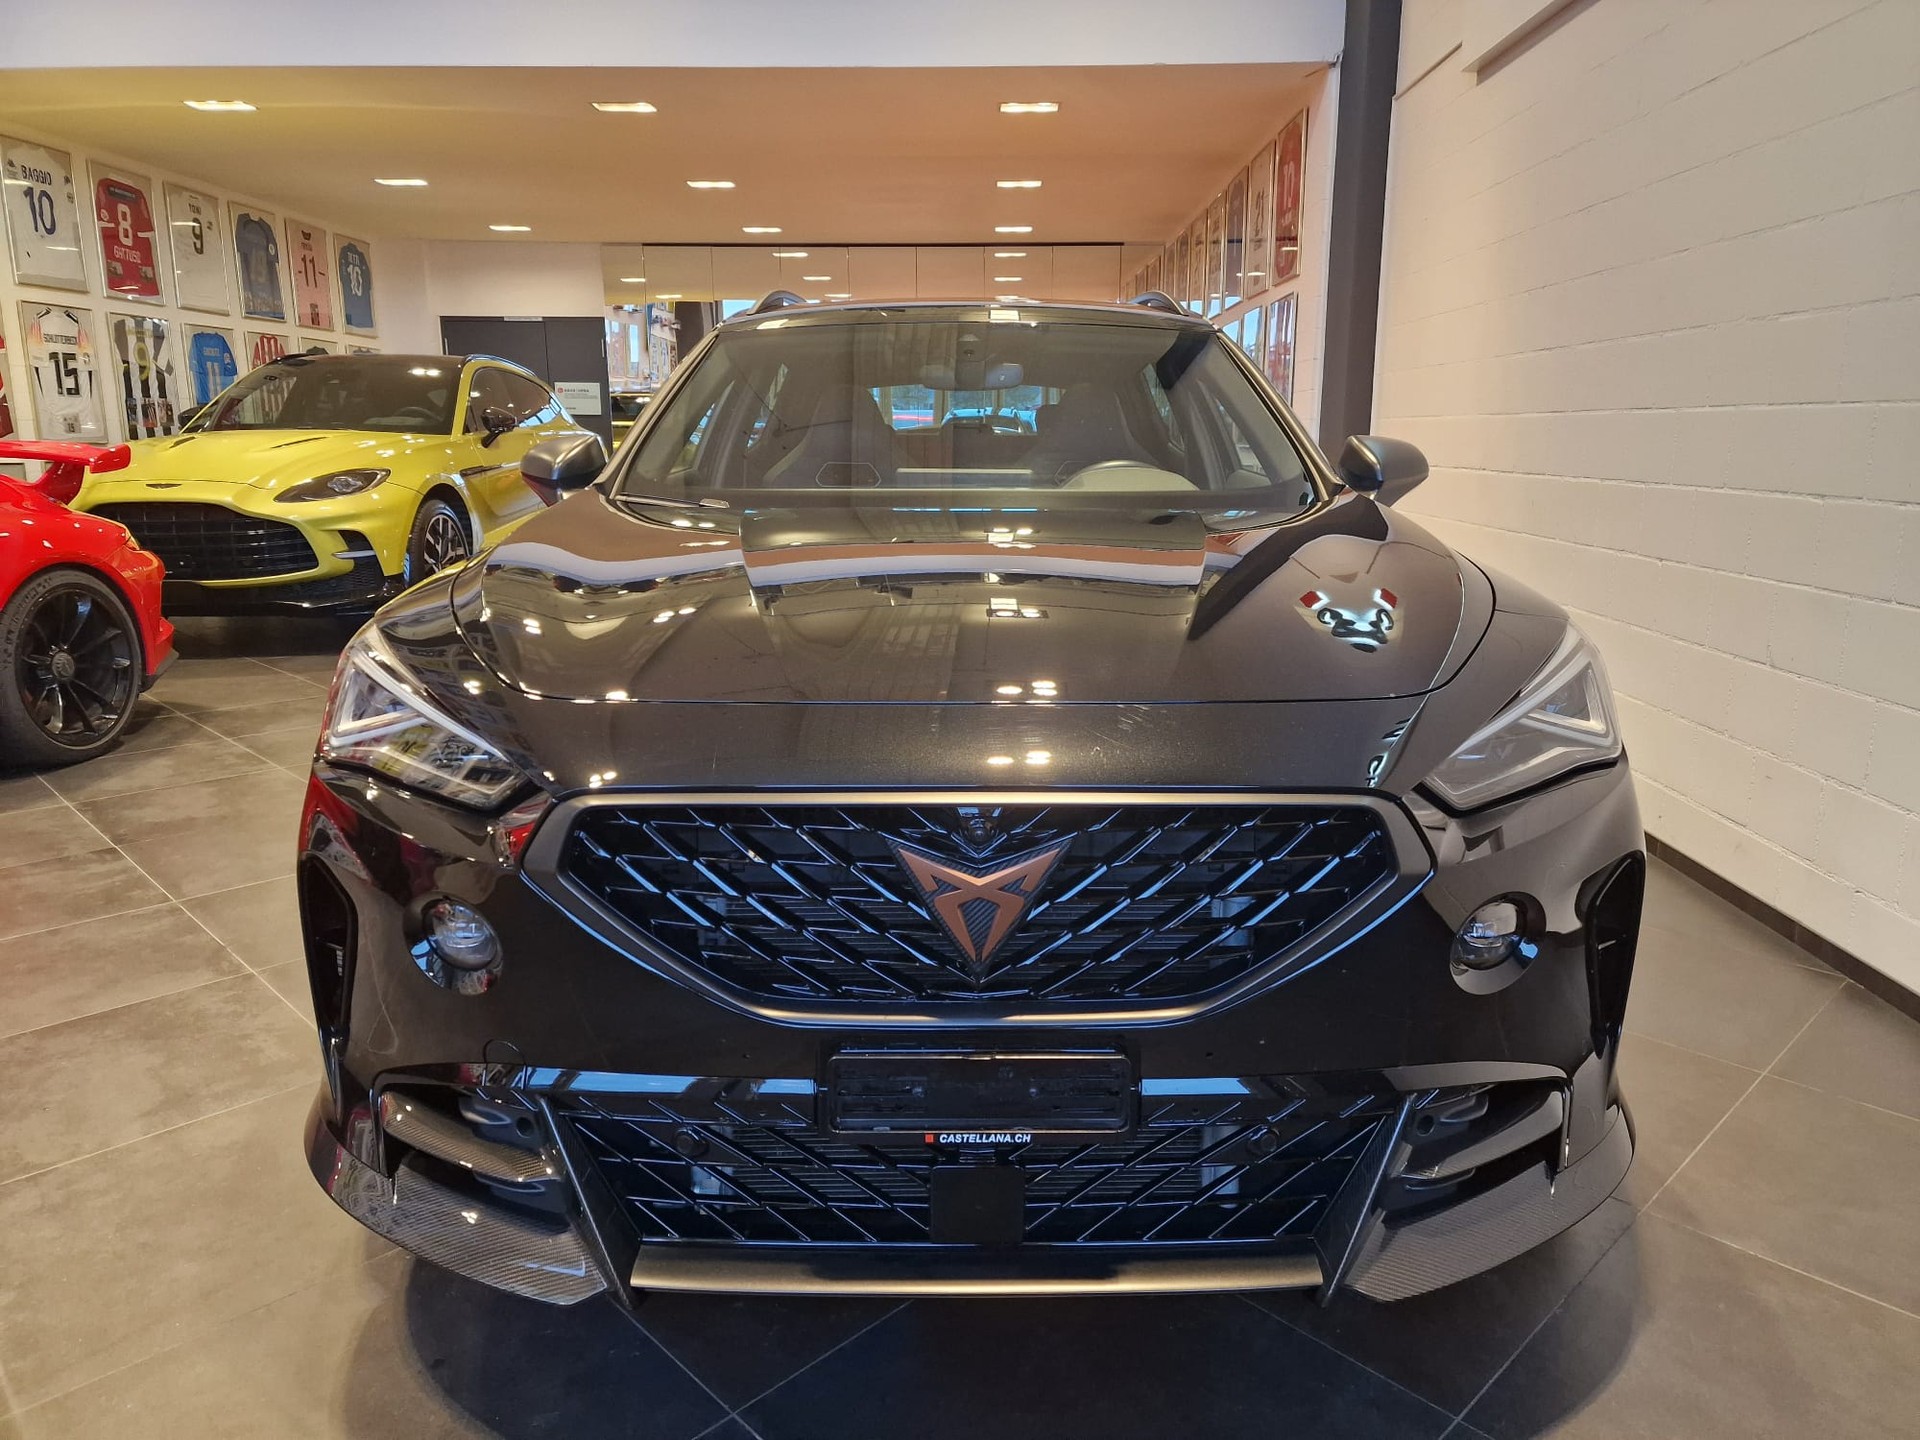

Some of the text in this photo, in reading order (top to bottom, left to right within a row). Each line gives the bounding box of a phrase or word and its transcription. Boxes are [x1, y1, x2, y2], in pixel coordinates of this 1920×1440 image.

[20, 165, 52, 186] BAGGIO
[23, 186, 56, 235] 10
[117, 202, 133, 247] 8
[192, 217, 204, 255] 9
[347, 264, 363, 297] 10
[48, 351, 81, 396] 15
[133, 341, 151, 382] 9
[939, 1133, 1032, 1144] CASTELLANA.CH
